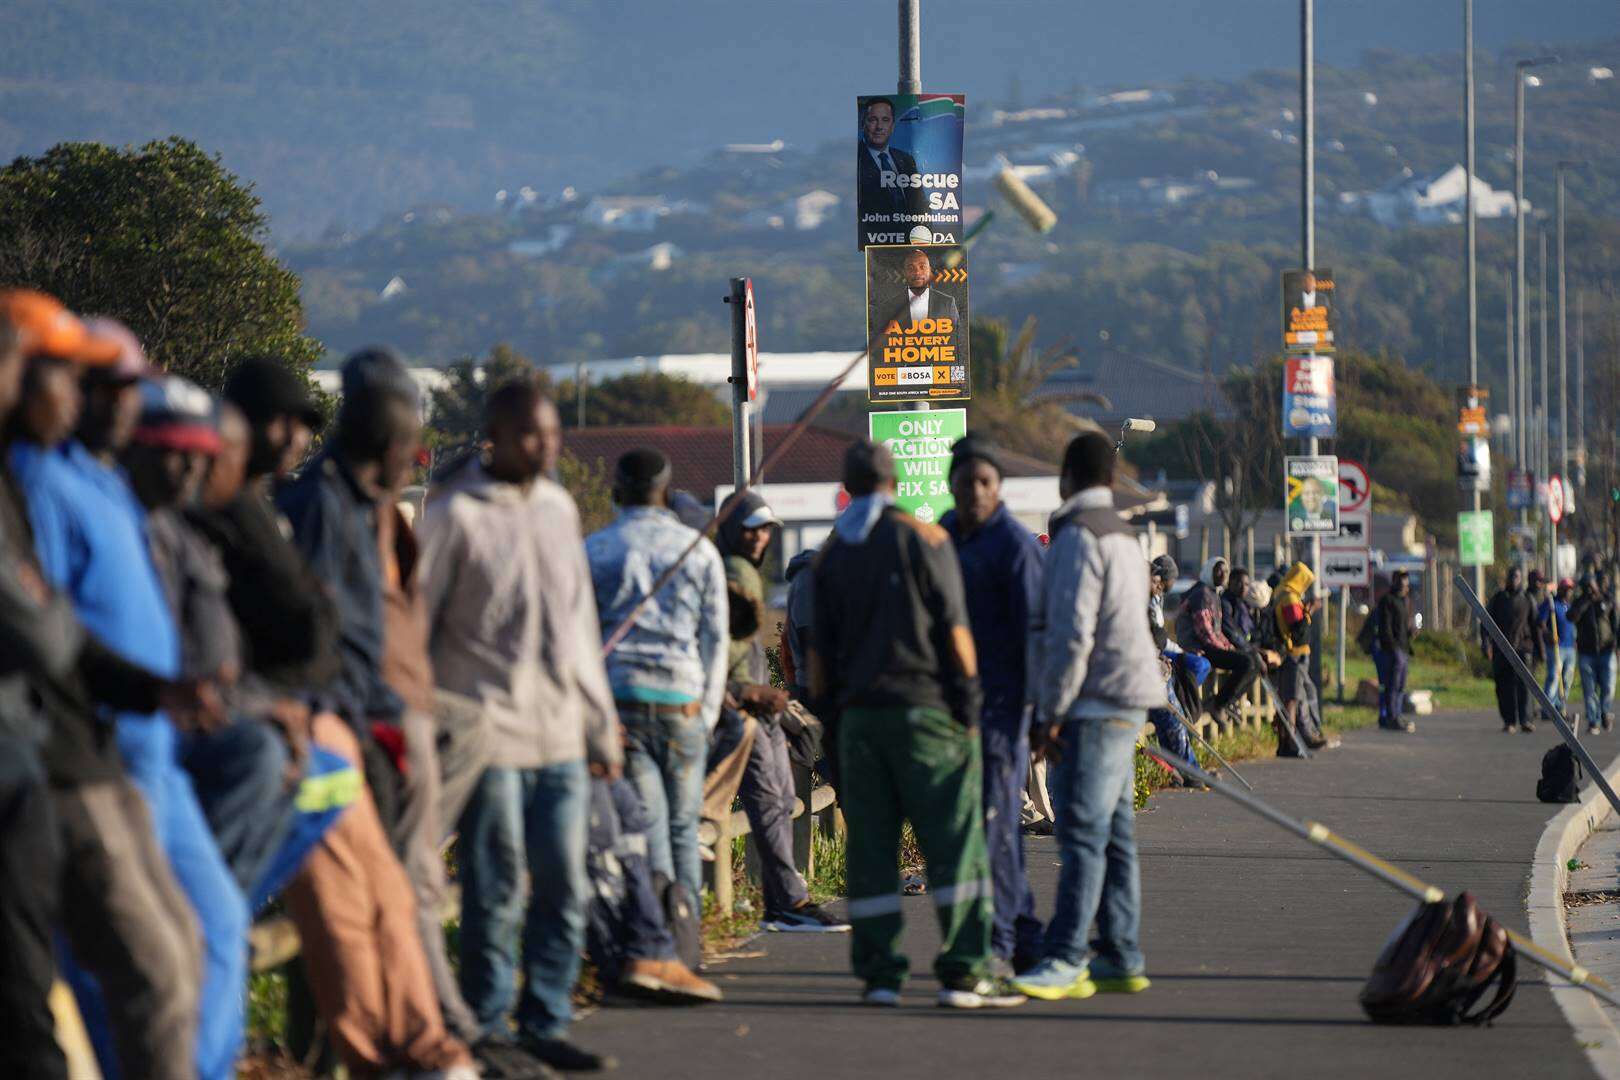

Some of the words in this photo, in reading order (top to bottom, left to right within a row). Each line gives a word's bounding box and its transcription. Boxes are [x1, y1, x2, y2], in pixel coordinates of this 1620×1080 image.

[880, 170, 959, 188] Rescue
[928, 192, 959, 210] SA
[862, 213, 890, 222] John
[892, 212, 959, 223] Steenhuisen
[867, 232, 905, 243] VOTE
[932, 232, 956, 244] DA
[885, 319, 903, 334] A
[904, 318, 953, 334] JOB
[888, 337, 902, 346] IN
[905, 335, 950, 346] EVERY
[883, 346, 956, 363] HOME
[907, 371, 931, 379] BOSA
[898, 419, 943, 436] ONLY
[891, 441, 951, 456] ACTION
[903, 461, 943, 476] WILL
[897, 481, 925, 497] FIX
[930, 480, 950, 495] SA
